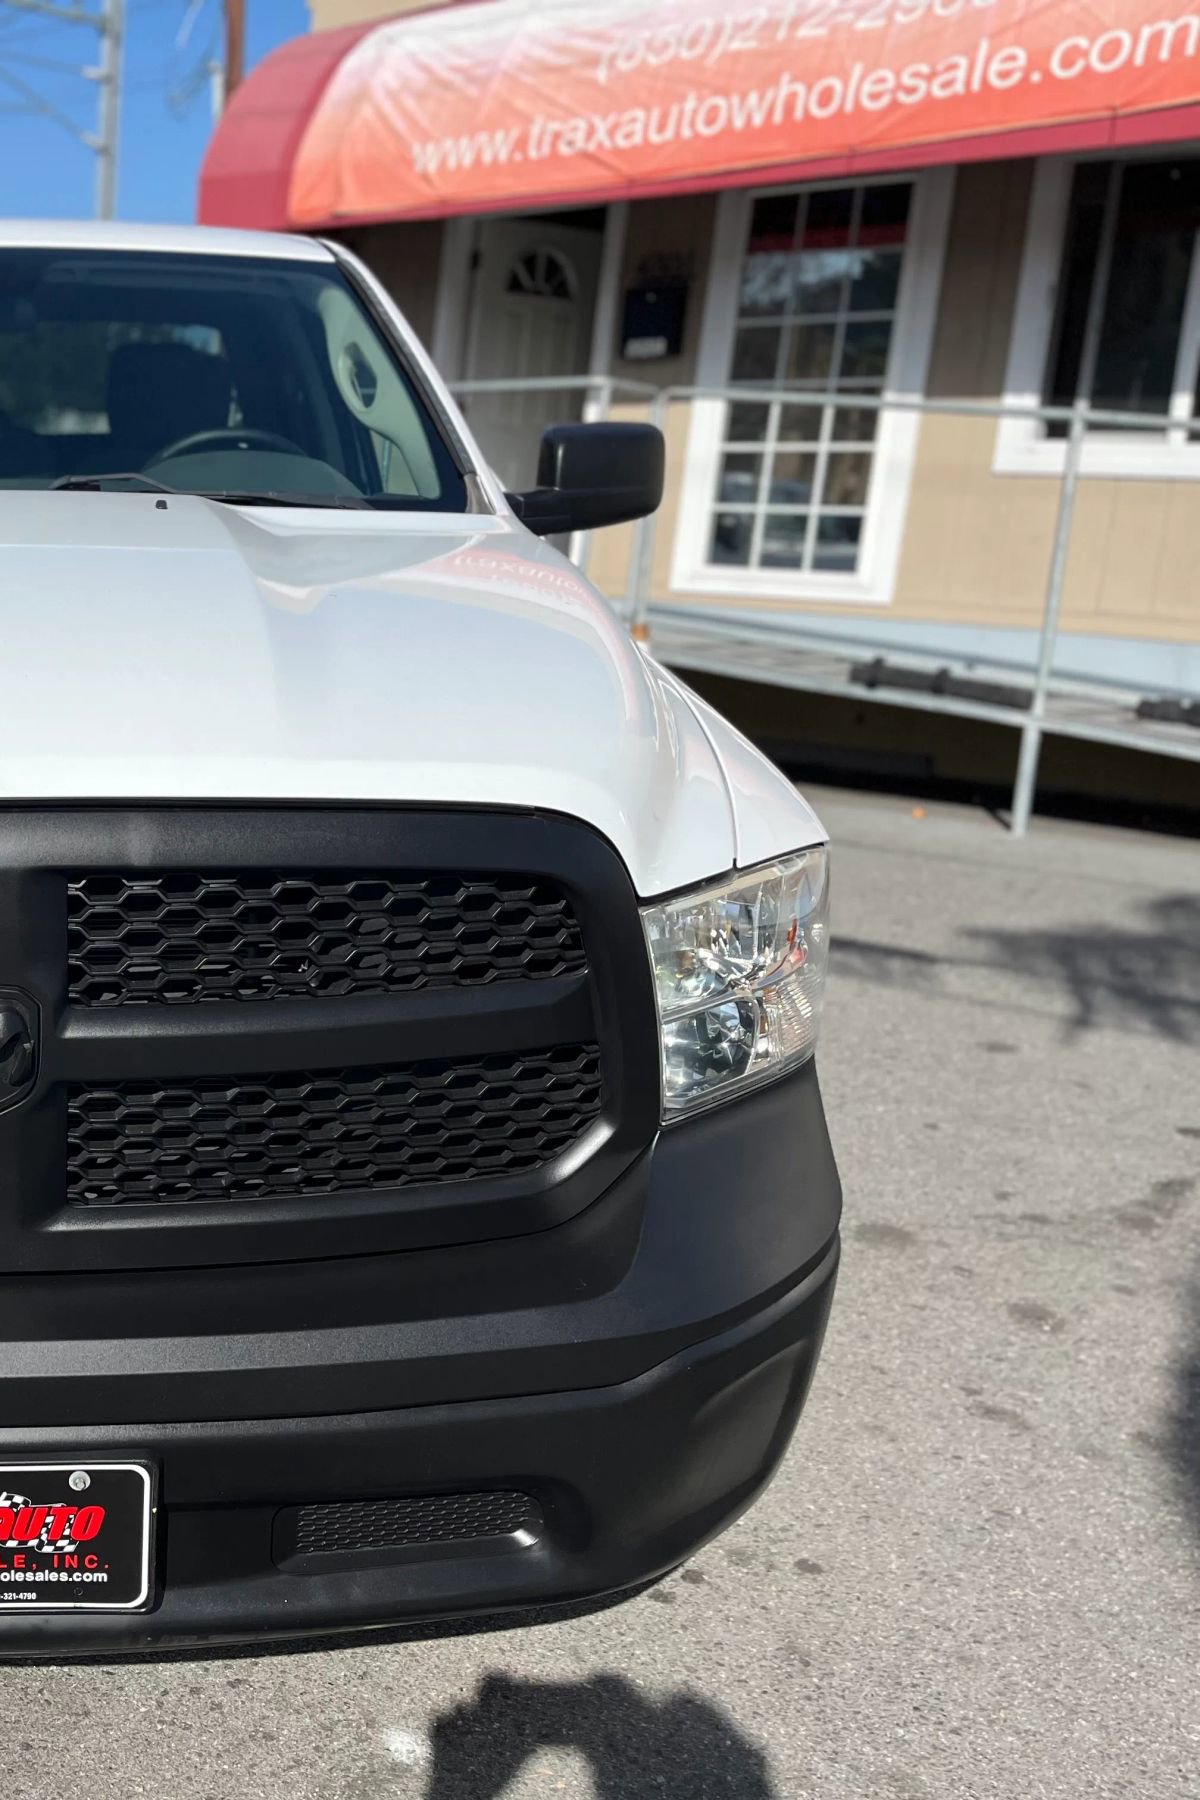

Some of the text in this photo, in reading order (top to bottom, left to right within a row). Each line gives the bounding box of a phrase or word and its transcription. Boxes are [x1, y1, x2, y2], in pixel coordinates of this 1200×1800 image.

[596, 0, 996, 84] (650)212-29
[411, 14, 1200, 175] www.traxautowholesale.com
[54, 1553, 110, 1569] INC.
